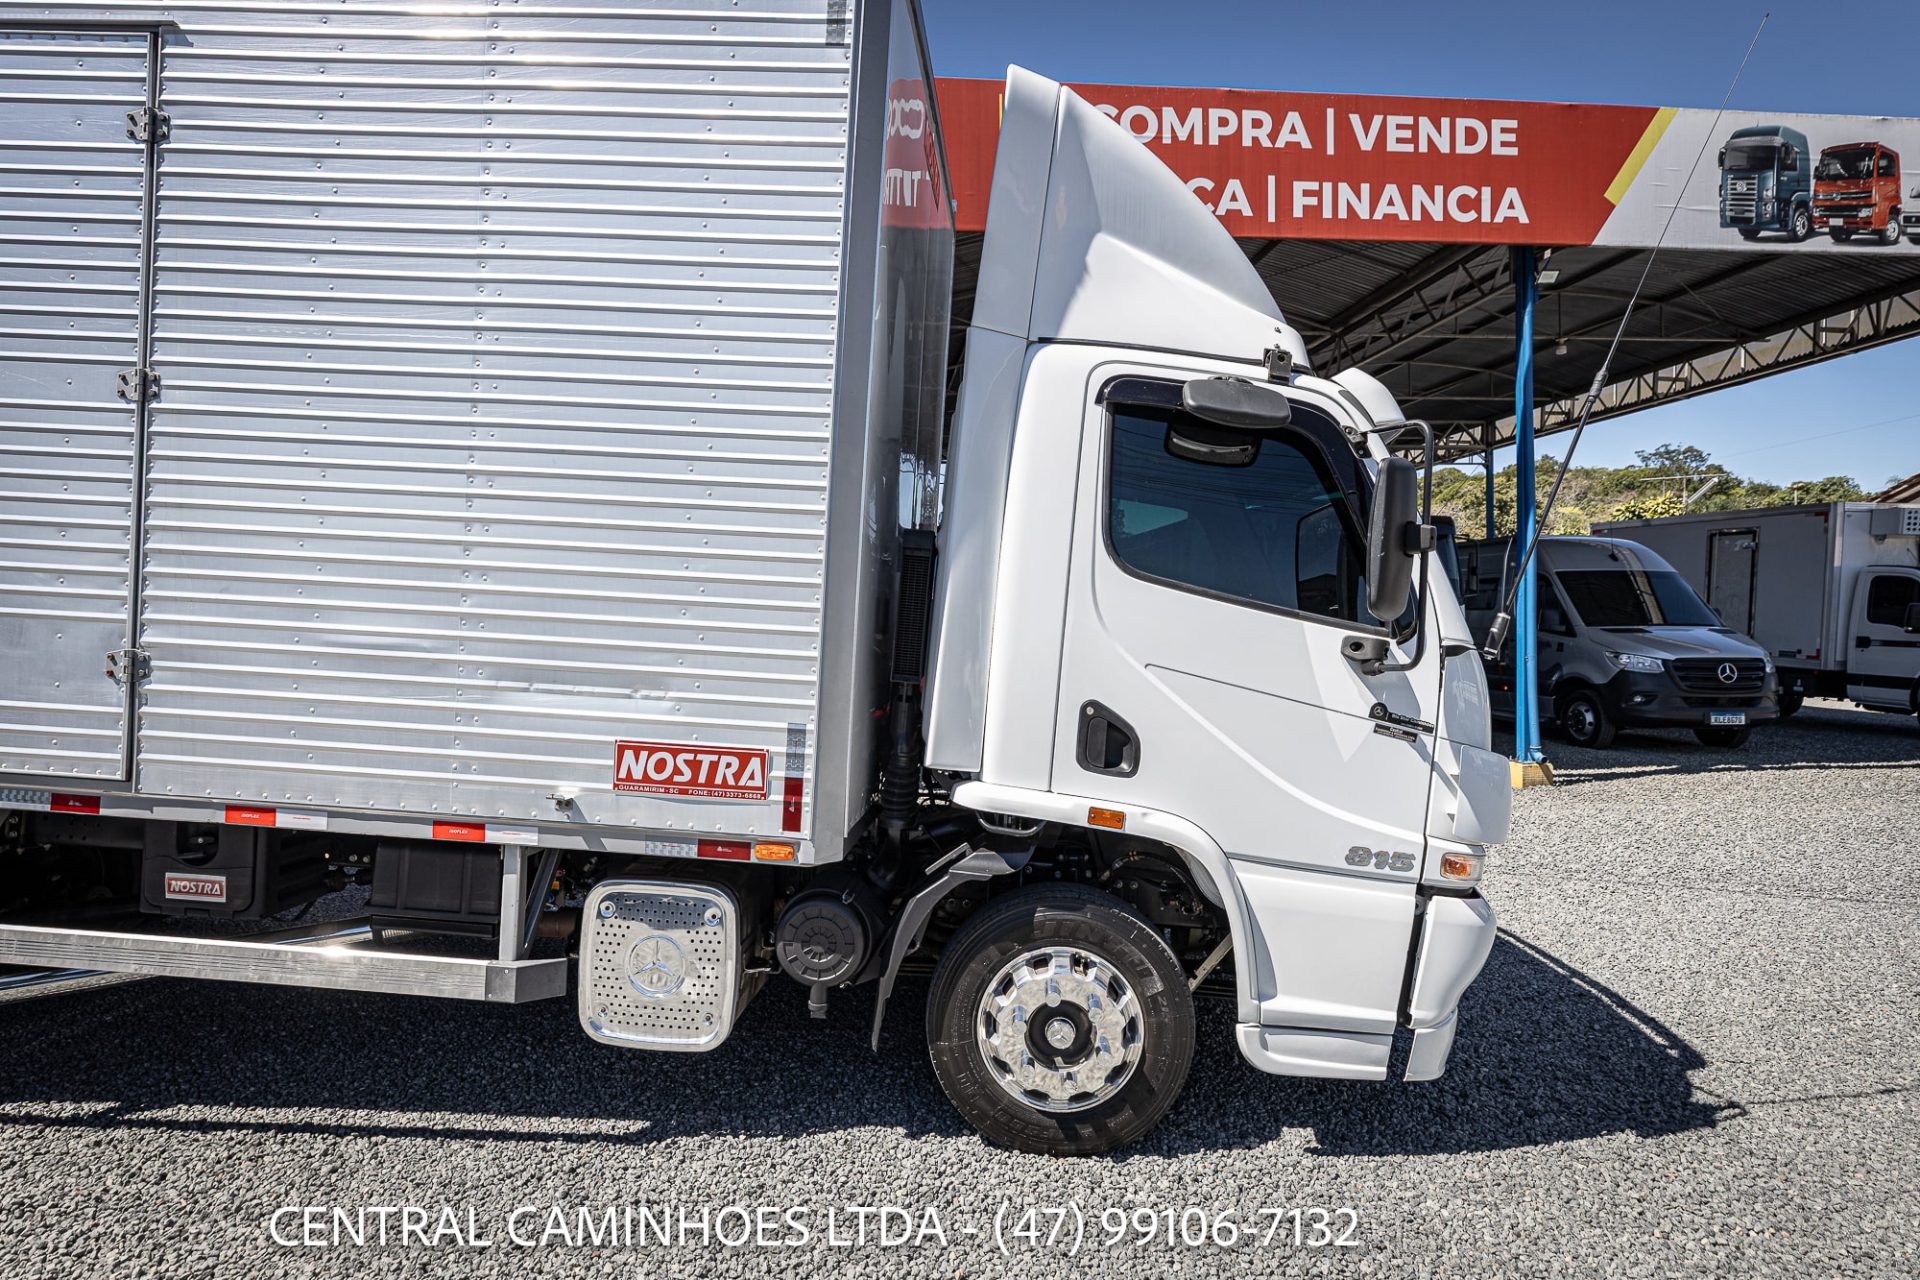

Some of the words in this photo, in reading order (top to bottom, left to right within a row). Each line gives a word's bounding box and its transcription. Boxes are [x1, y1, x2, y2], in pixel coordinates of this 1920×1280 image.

[1349, 113, 1519, 156] VENDE
[1292, 180, 1530, 224] FINANCIA
[618, 749, 763, 788] NOSTRA
[618, 785, 665, 793] GUARAMIRIM
[170, 880, 221, 895] NOSTRA
